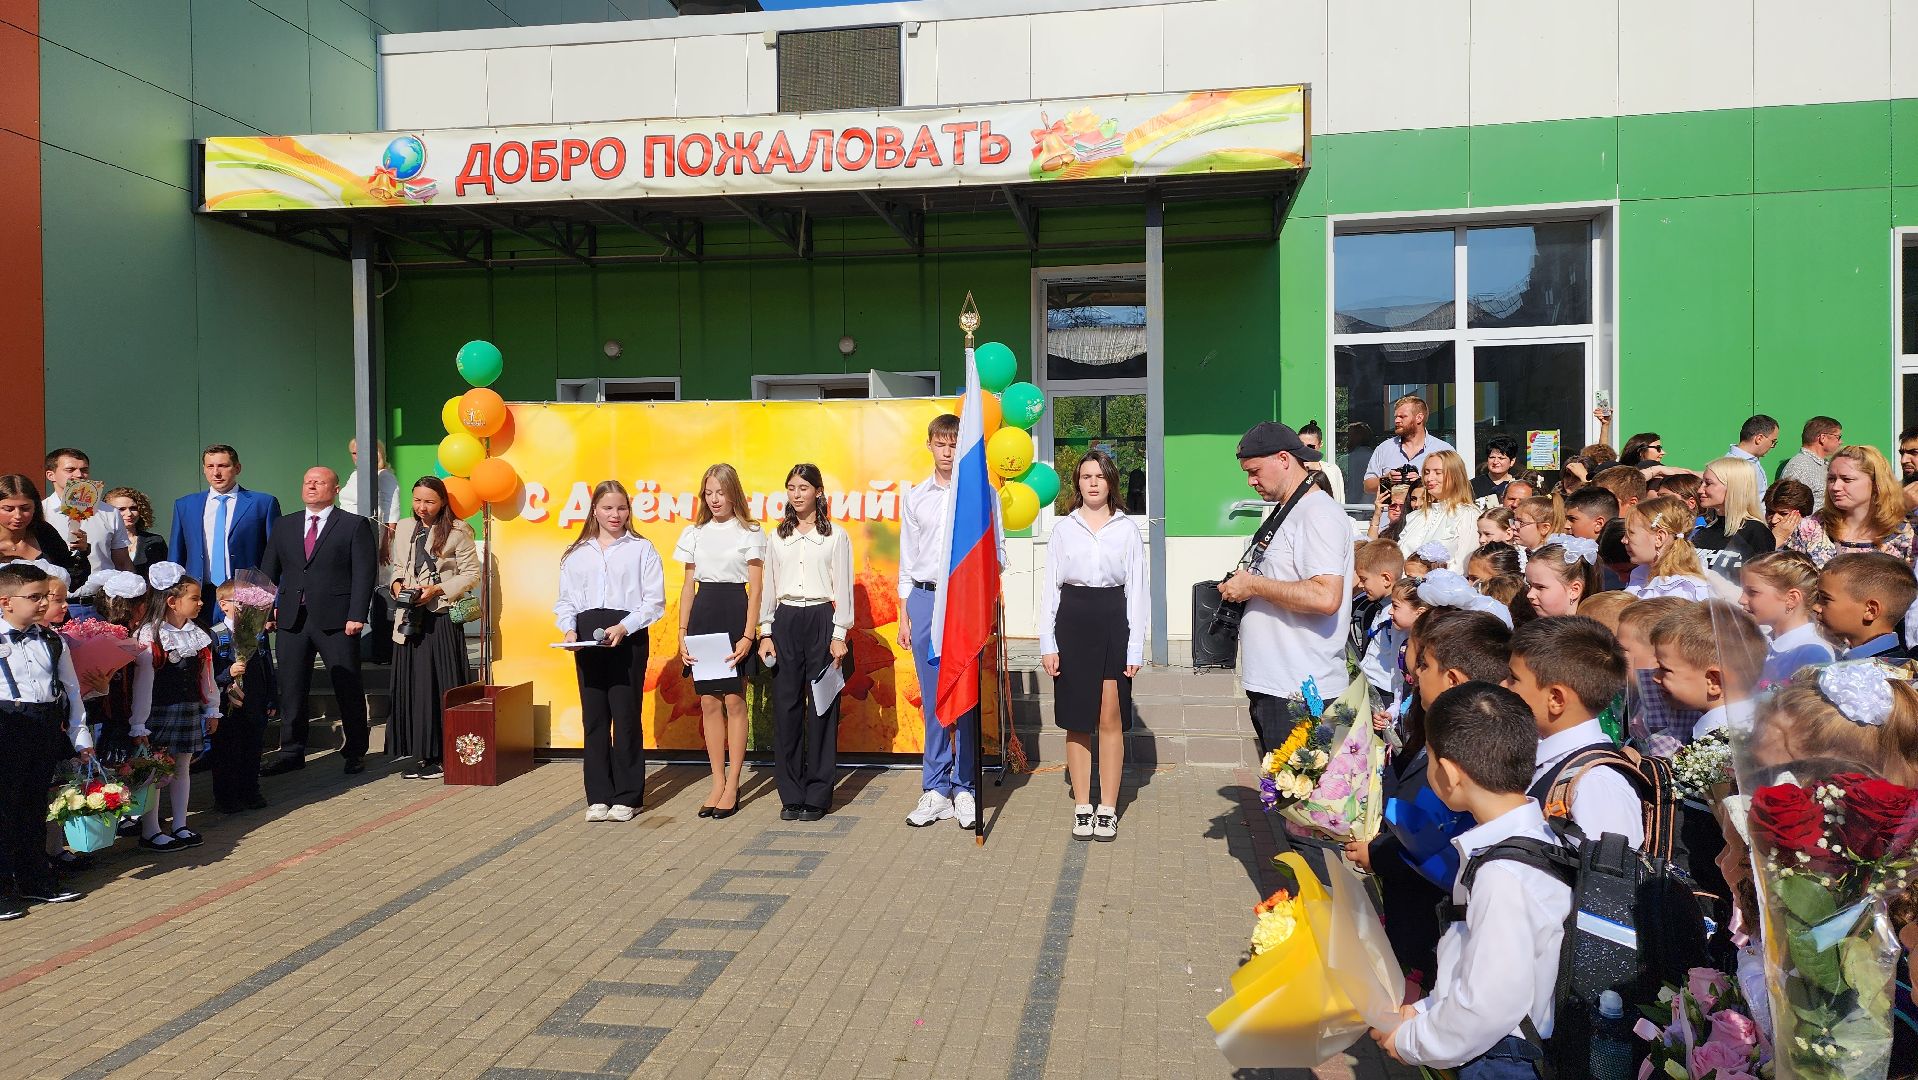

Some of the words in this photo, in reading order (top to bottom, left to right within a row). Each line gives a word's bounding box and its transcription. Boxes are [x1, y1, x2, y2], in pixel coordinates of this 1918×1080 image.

[455, 136, 626, 196] ДОБРО
[643, 120, 1011, 178] ПОЖАЛОВАТЬ
[521, 482, 549, 523] С
[558, 479, 698, 529] Дём
